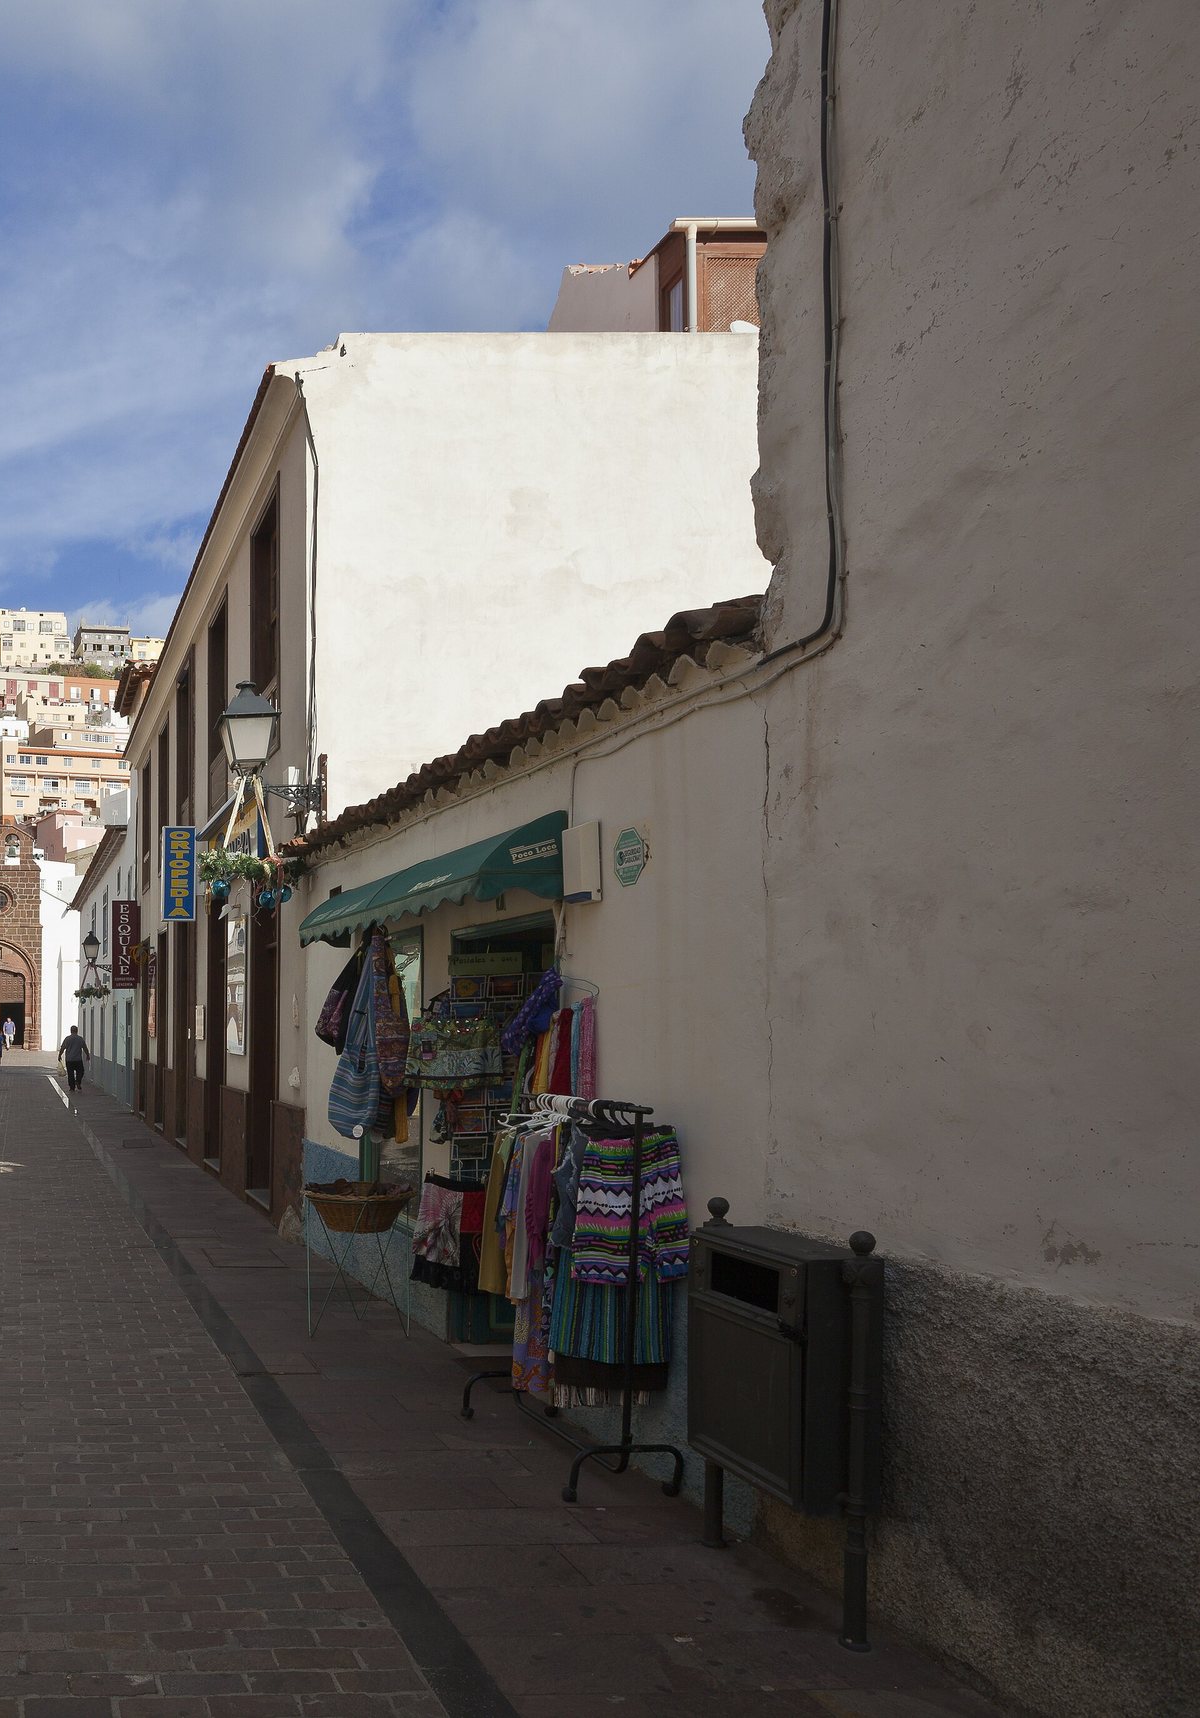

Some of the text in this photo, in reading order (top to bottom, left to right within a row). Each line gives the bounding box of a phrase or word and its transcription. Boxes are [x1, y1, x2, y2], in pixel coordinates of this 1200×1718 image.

[168, 830, 191, 917] ORTOPEDIA
[511, 844, 557, 861] Poco Loco
[117, 904, 132, 976] ESQUINE
